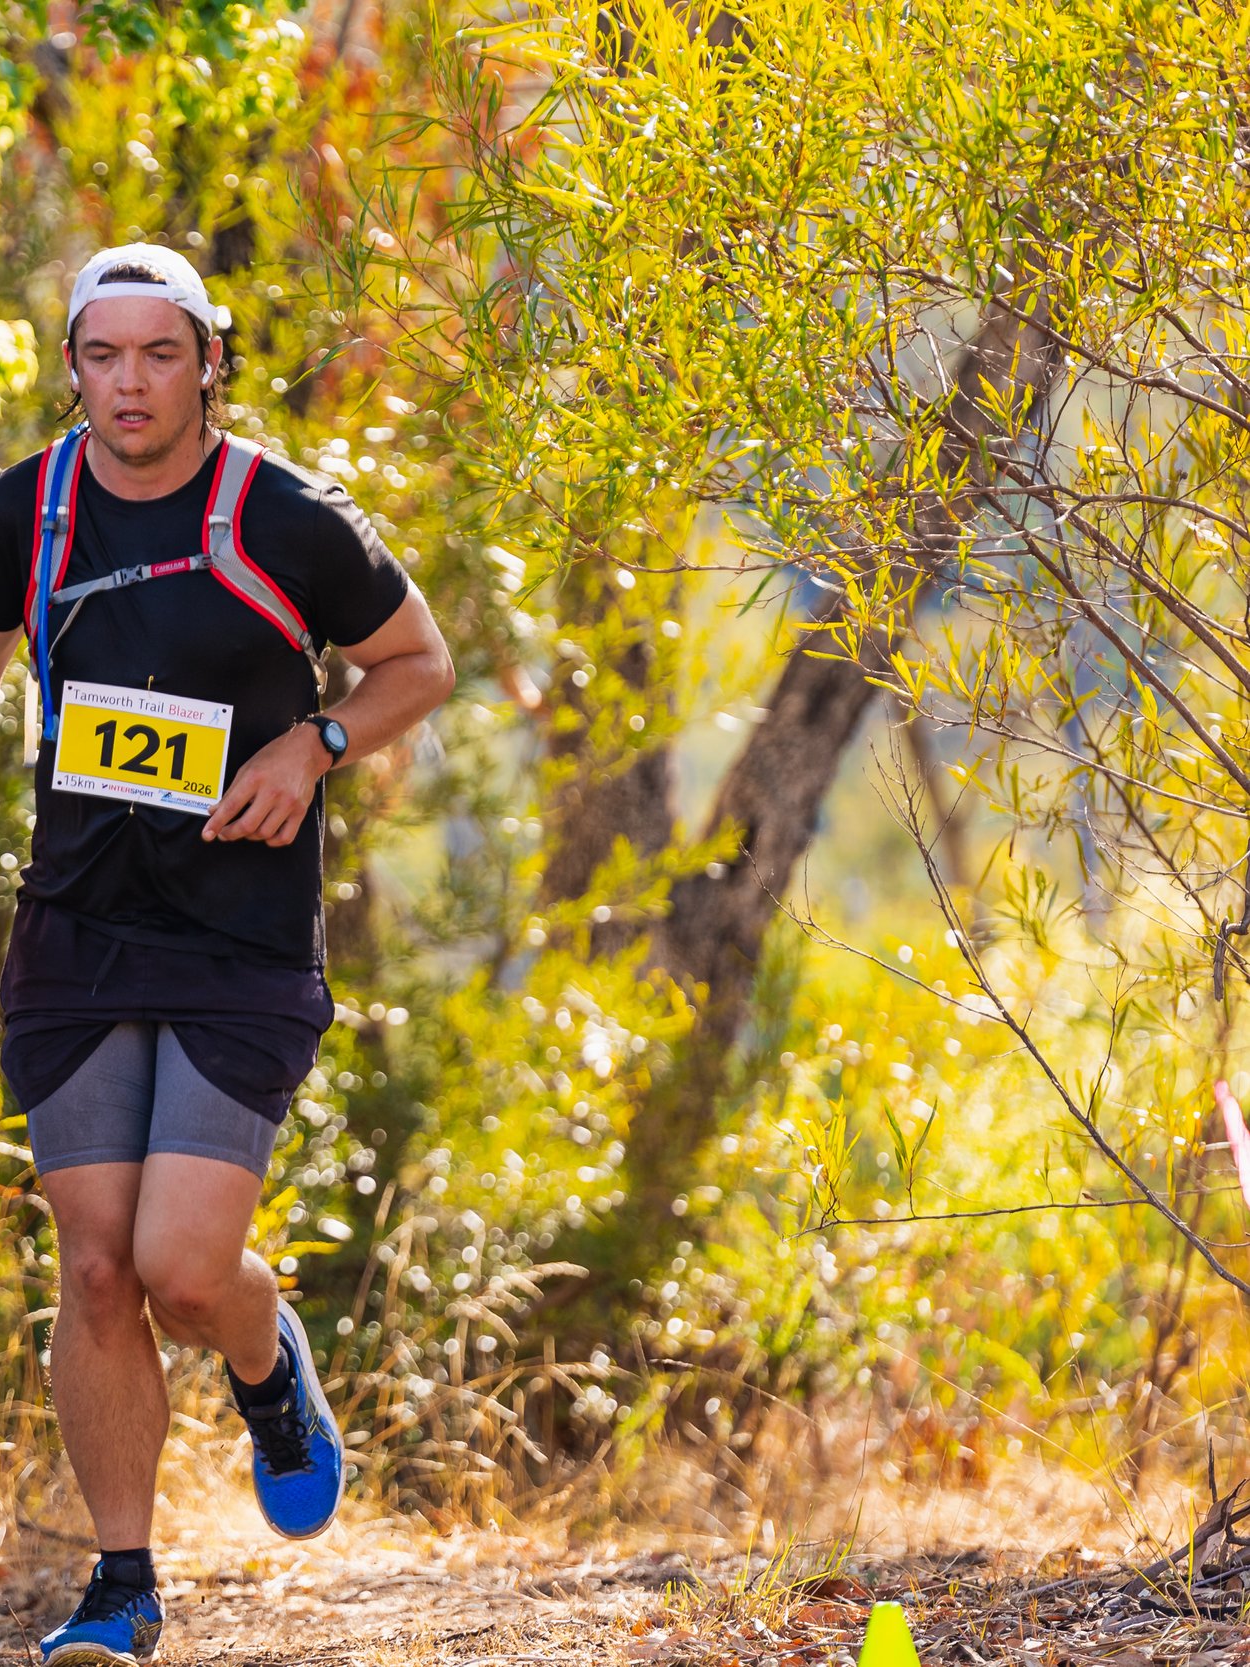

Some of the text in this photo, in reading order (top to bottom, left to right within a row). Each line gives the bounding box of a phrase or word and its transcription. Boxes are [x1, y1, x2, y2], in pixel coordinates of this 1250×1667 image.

[73, 689, 205, 720] Tamworth Trail Blazer
[95, 719, 188, 780] 121
[63, 775, 95, 790] 15km
[183, 780, 212, 795] 2026
[108, 784, 154, 797] INTERSPORT
